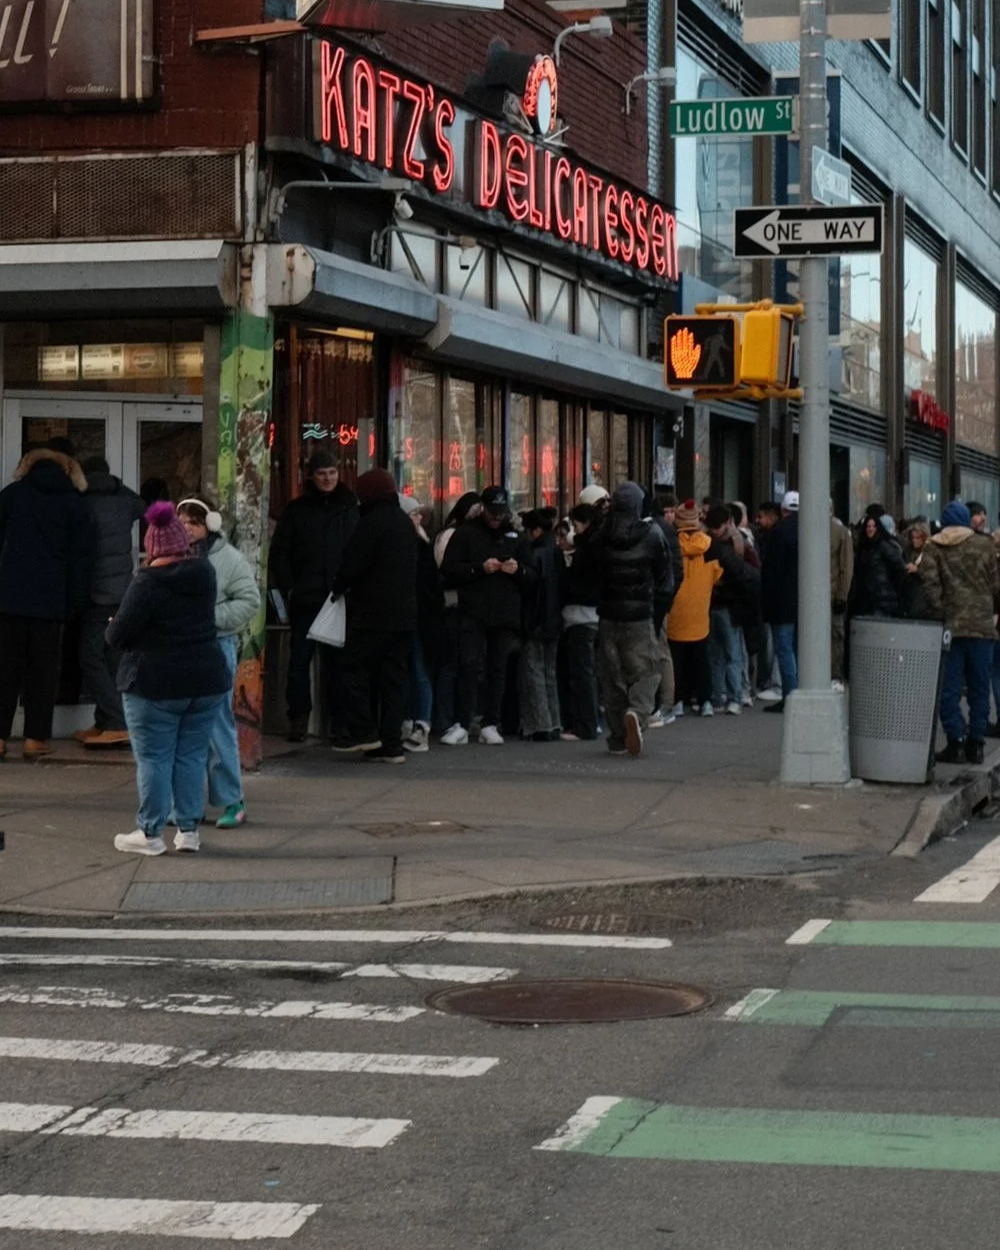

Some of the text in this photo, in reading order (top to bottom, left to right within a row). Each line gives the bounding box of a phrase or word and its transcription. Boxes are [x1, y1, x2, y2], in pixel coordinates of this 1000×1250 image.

[320, 40, 457, 193] KATZ'S
[676, 101, 791, 133] Ludlow St
[763, 220, 866, 241] ONE WAY
